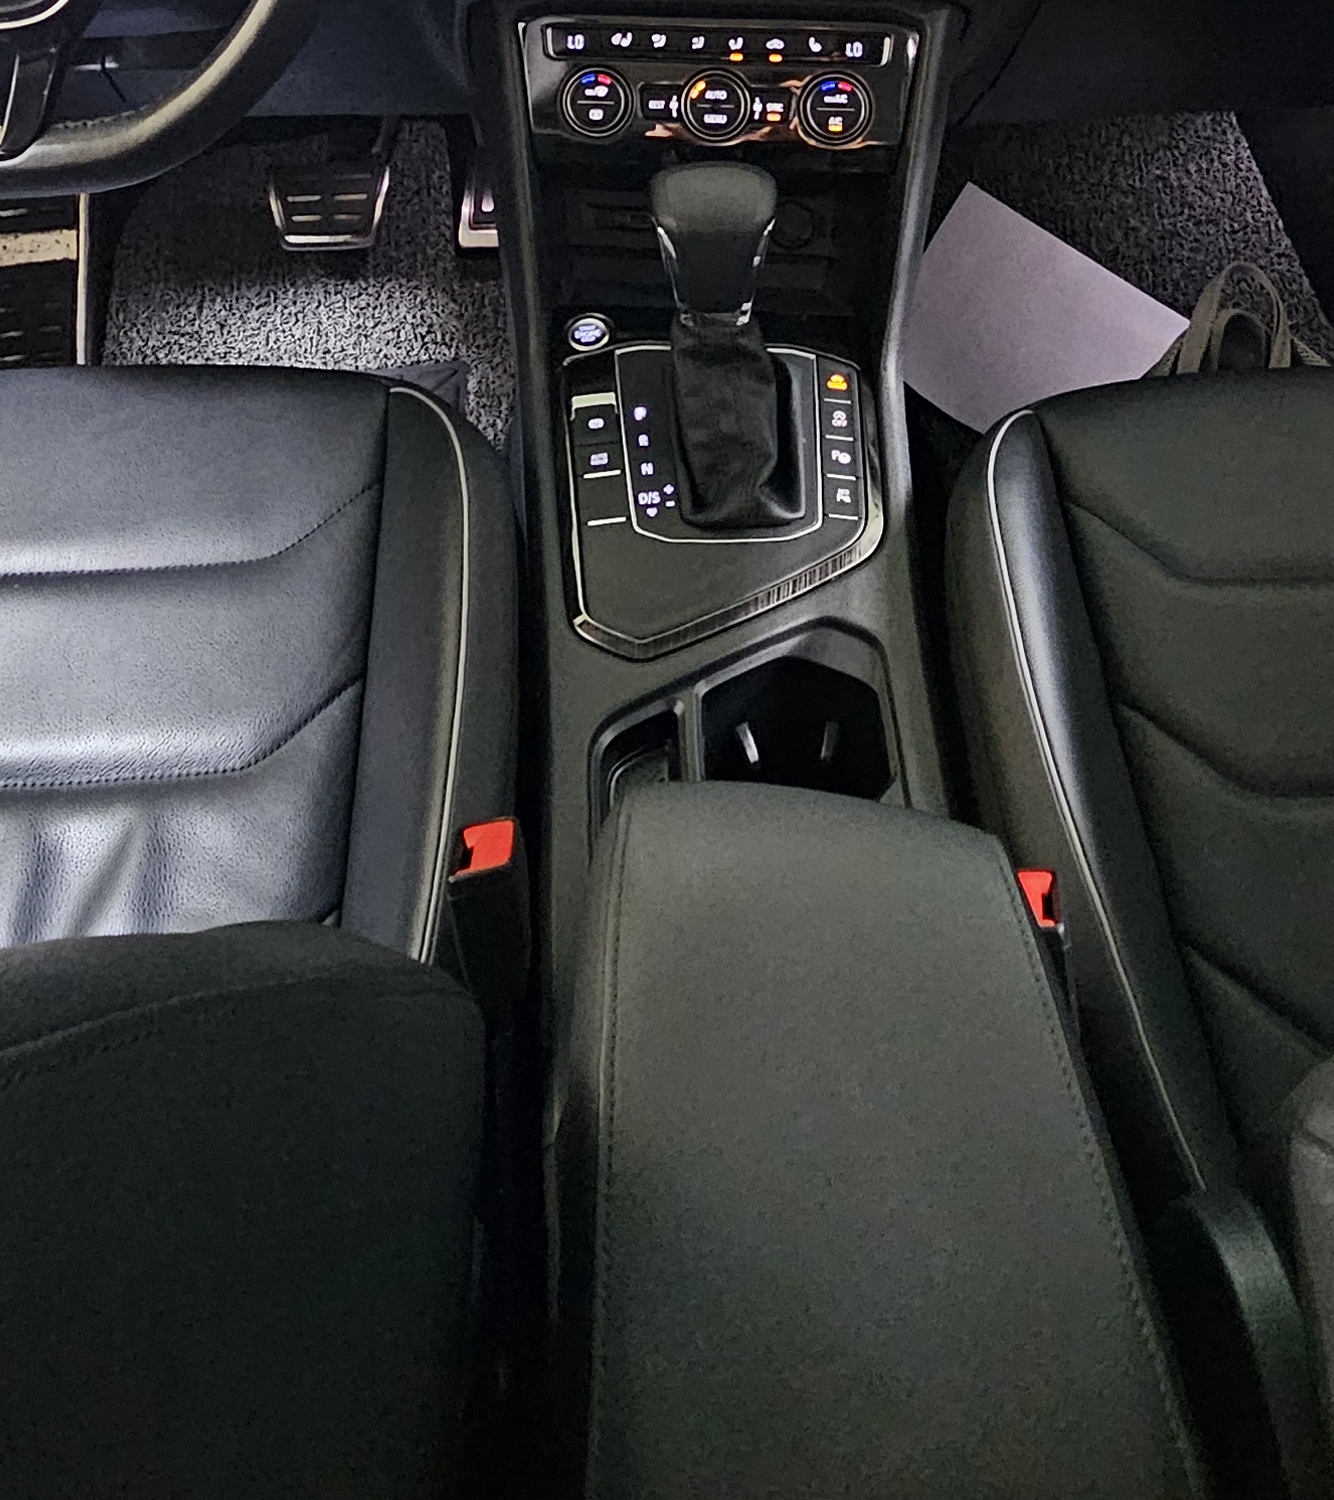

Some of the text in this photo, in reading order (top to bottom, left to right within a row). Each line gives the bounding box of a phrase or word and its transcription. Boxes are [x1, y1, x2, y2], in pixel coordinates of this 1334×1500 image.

[566, 33, 586, 50] LO
[845, 40, 864, 58] LO
[640, 462, 654, 476] N
[637, 490, 662, 505] D/S
